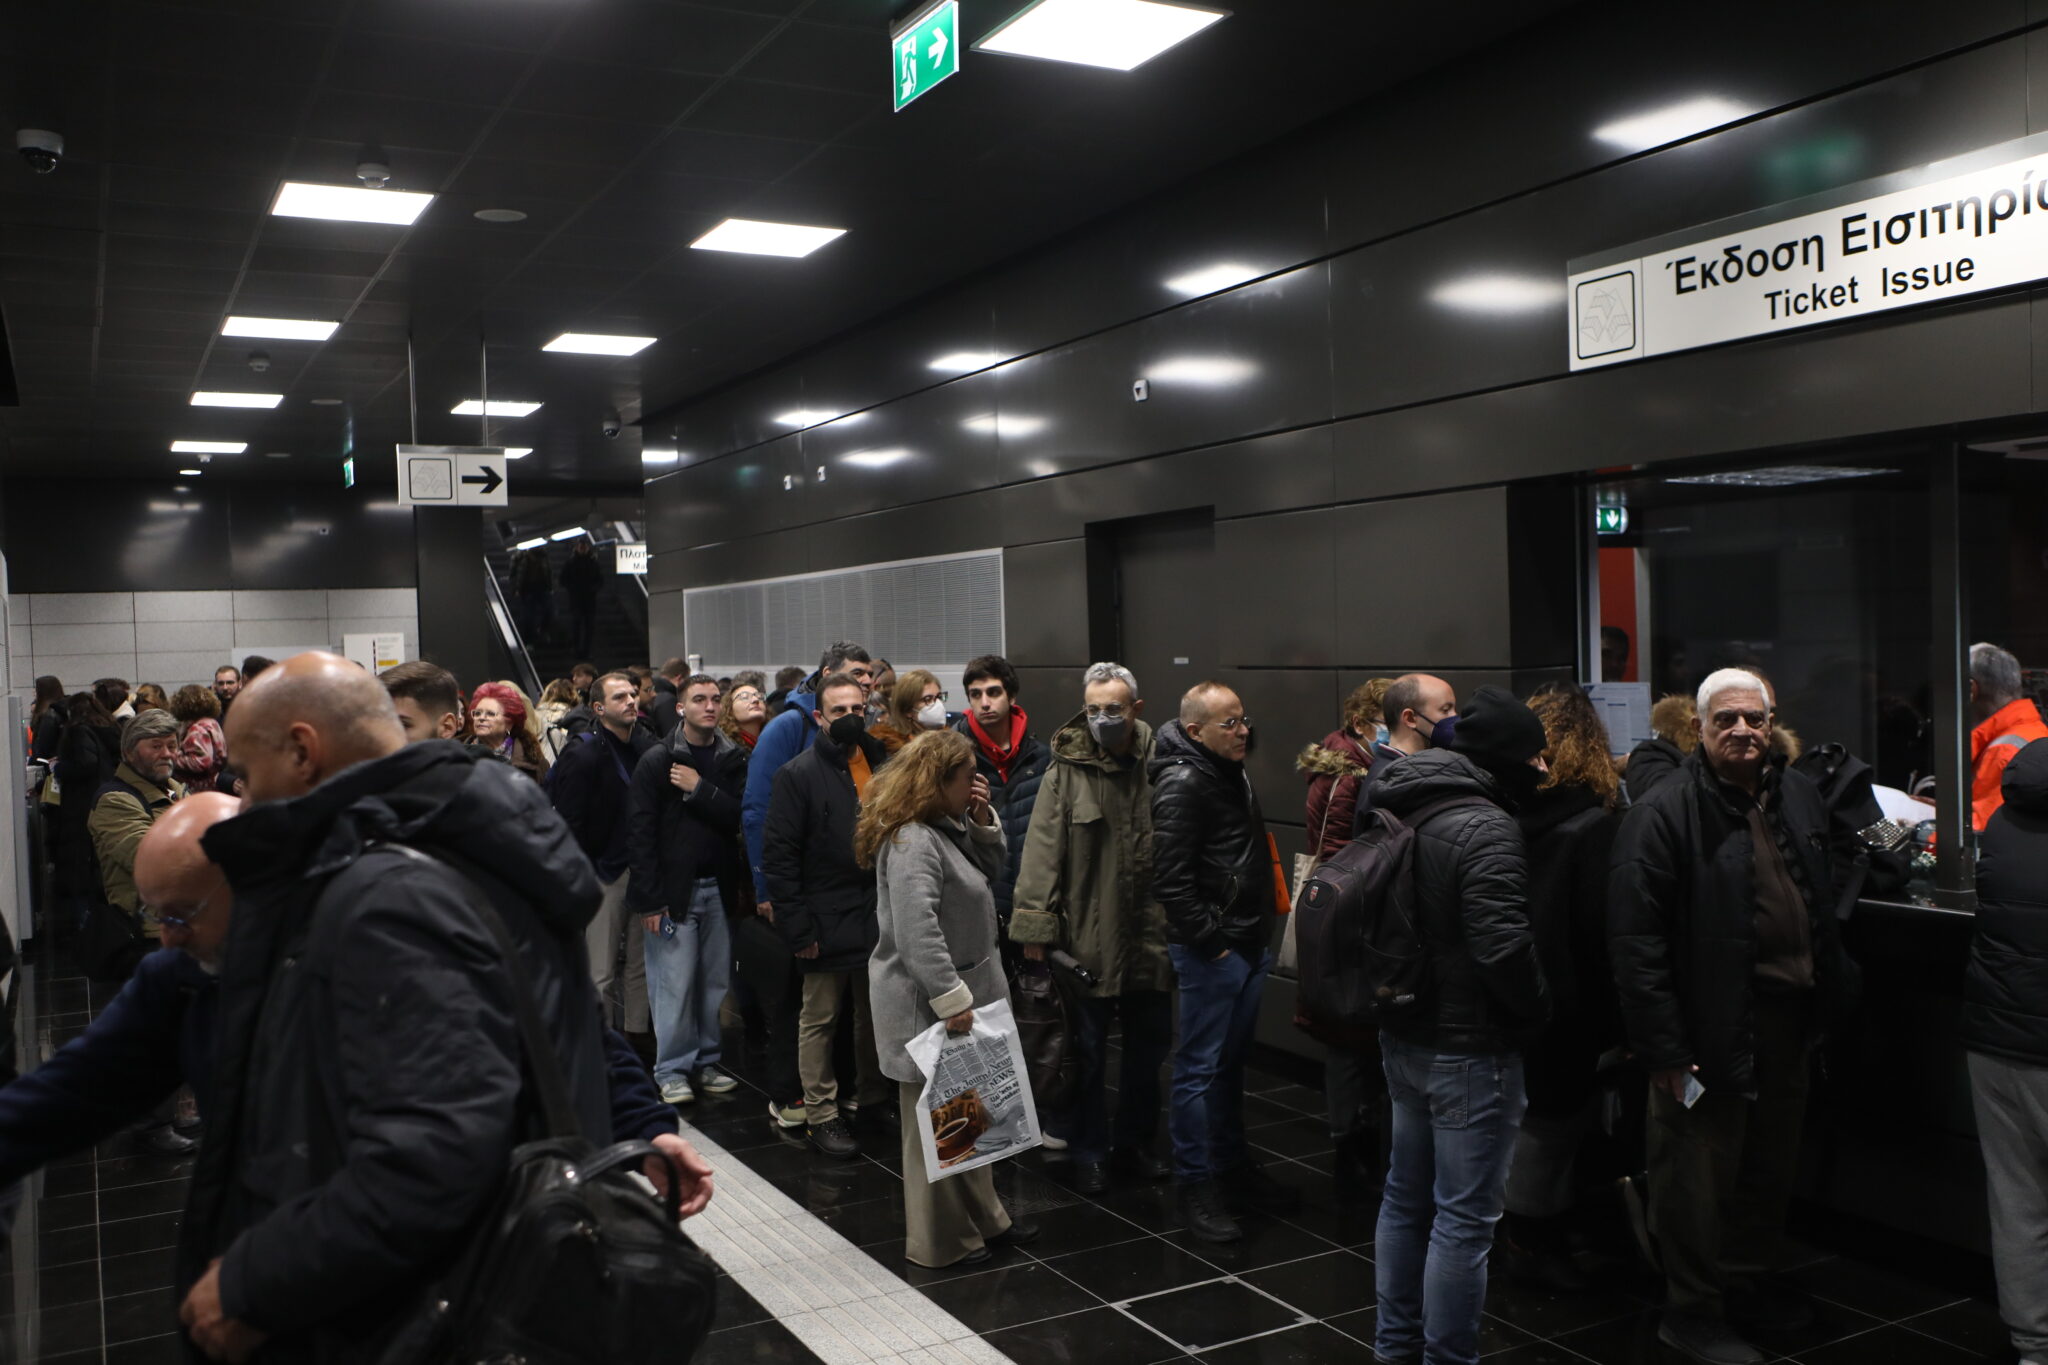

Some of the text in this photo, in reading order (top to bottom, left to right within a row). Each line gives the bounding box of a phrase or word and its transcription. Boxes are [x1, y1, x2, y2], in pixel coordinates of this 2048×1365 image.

[1665, 232, 1824, 295] Έκδοση
[1764, 257, 1975, 320] Ticket Issue
[944, 1085, 963, 1099] The
[989, 1067, 1016, 1091] NEWS
